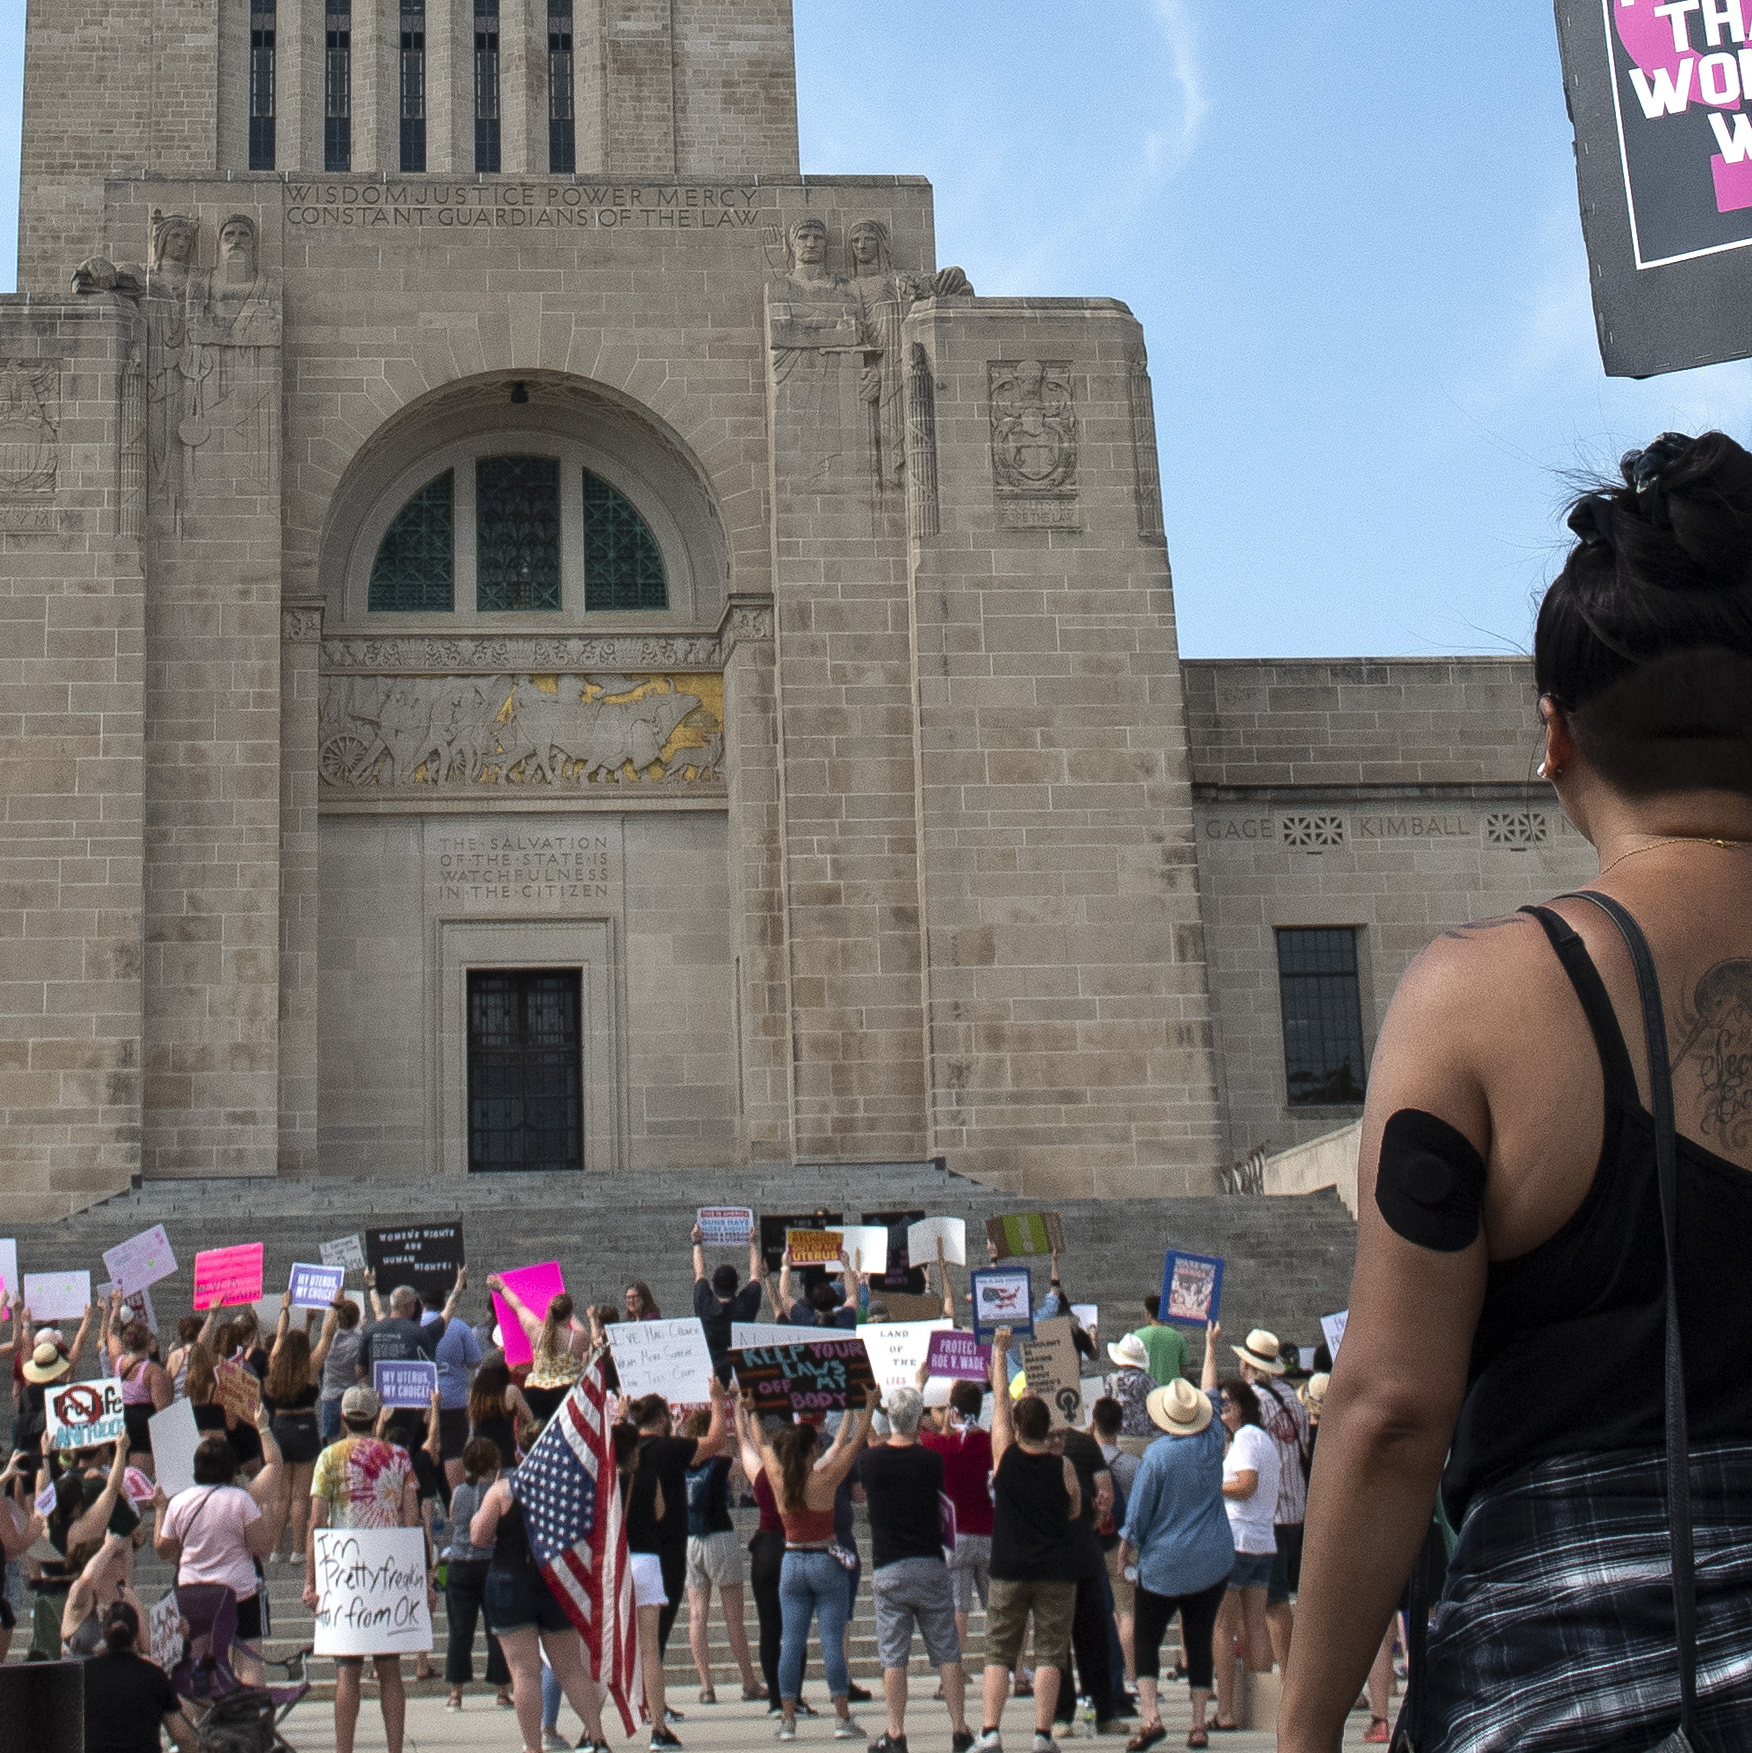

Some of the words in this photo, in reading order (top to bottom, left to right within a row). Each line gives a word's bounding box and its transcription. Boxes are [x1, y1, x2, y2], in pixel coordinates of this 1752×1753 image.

[286, 186, 407, 205] WISDOM
[415, 186, 535, 206] JUSTICE
[548, 188, 642, 207] POWER
[657, 188, 758, 208] MERCY
[286, 207, 430, 225] CONSTANT
[438, 207, 588, 227] GUARDIANS
[598, 209, 632, 227] OF
[639, 210, 691, 228] THE
[702, 210, 759, 228] LAW
[1205, 818, 1274, 840] GAGE
[1359, 815, 1471, 838] KIMBALL
[440, 837, 477, 851] THE
[490, 837, 607, 850] SALVATION
[440, 854, 464, 867] OF
[471, 854, 510, 866] THE
[522, 853, 584, 866] STATE
[593, 853, 608, 865] IS
[440, 869, 608, 883] WATCHFULNESS
[439, 886, 460, 899] IN
[470, 886, 510, 898] THE
[521, 885, 608, 898] CITIZEN
[792, 1251, 839, 1261] UTERUS
[298, 1273, 308, 1286] MY
[295, 1286, 307, 1298] MY
[880, 1330, 909, 1338] LAND
[742, 1344, 806, 1367] KEEP
[809, 1341, 865, 1360] YOUR
[889, 1345, 904, 1354] OF
[939, 1339, 978, 1355] PROTECT
[782, 1359, 846, 1378] LAWS
[931, 1356, 948, 1369] ROE
[959, 1357, 985, 1371] WADE
[382, 1370, 395, 1383] MY
[383, 1385, 396, 1398] MY
[397, 1385, 431, 1398] CHOICE!
[758, 1378, 793, 1395] OFF
[816, 1374, 847, 1390] MY
[790, 1391, 848, 1410] BODY
[345, 1595, 392, 1629] from
